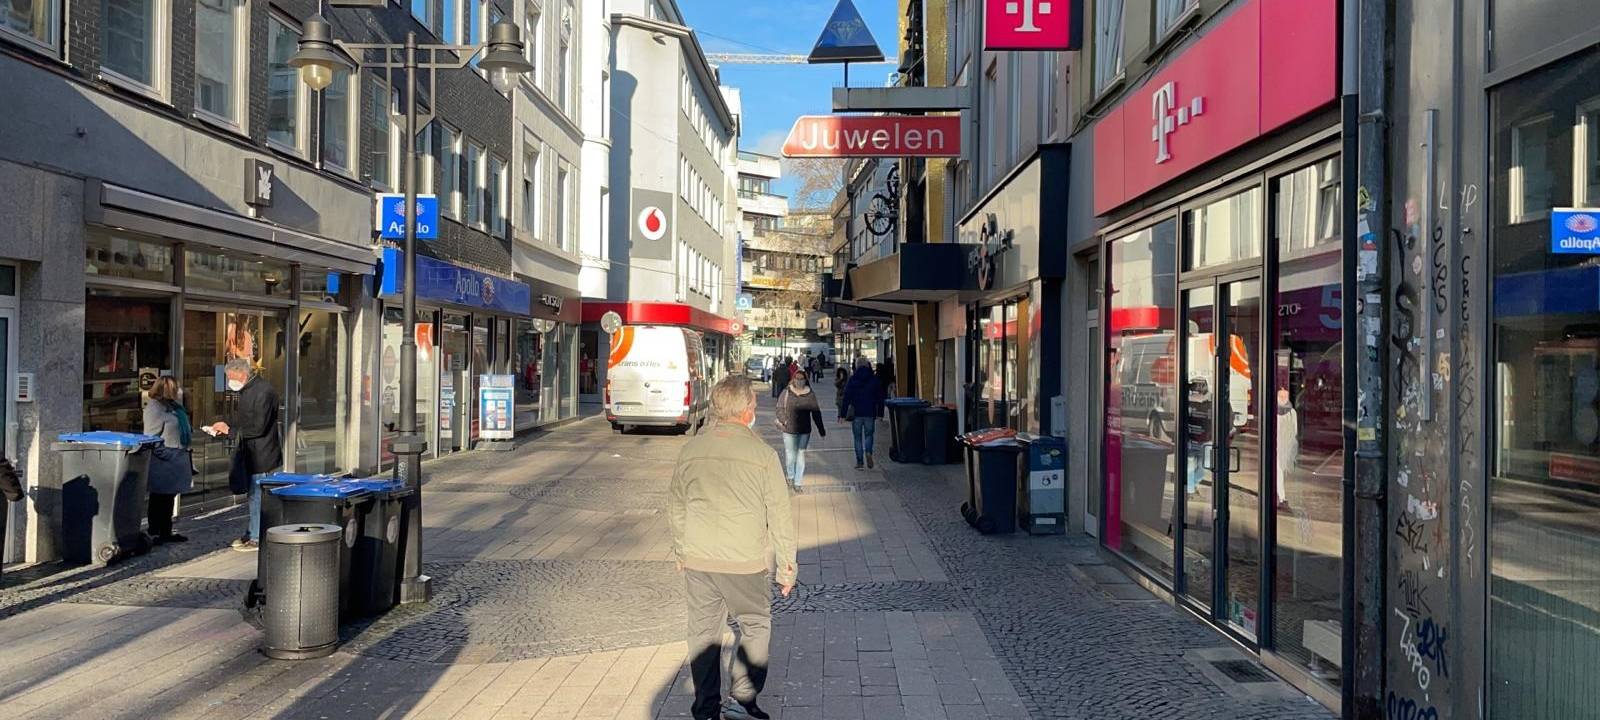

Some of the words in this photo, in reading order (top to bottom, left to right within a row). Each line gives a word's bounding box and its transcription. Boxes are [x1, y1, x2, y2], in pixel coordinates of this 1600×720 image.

[802, 122, 944, 150] Juwelen
[388, 221, 430, 236] Aplo
[455, 270, 480, 301] Apollo
